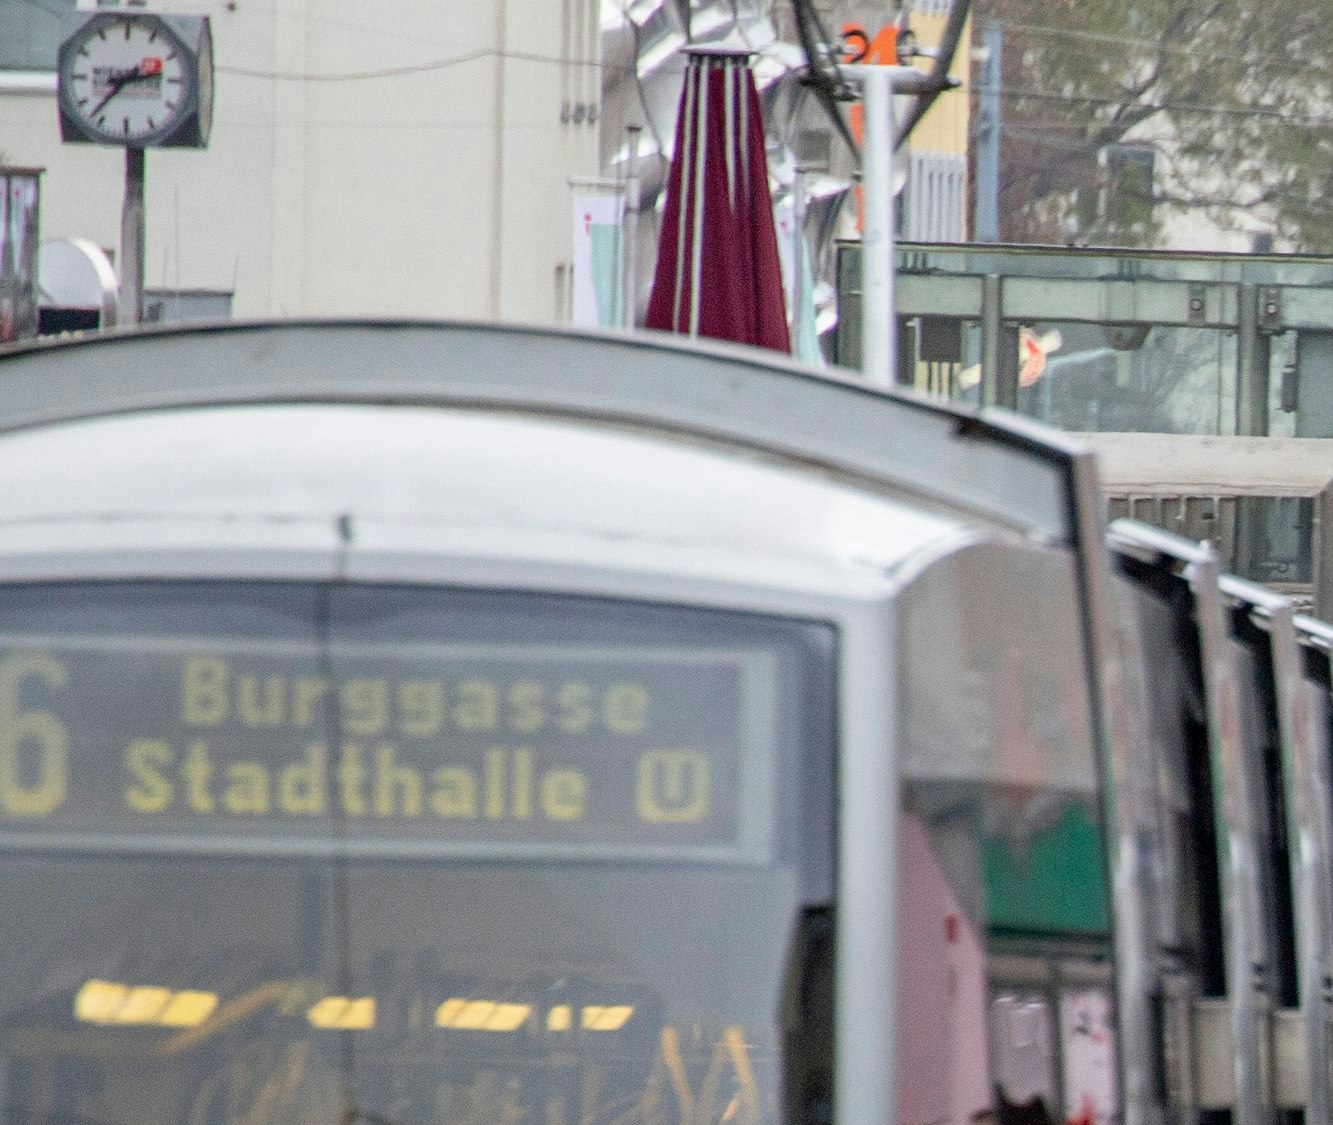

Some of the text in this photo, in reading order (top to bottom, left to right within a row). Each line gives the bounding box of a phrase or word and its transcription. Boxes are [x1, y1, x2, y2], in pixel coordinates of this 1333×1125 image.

[0, 648, 650, 819] 6 Burggasse
[122, 738, 591, 823] Stadthalle
